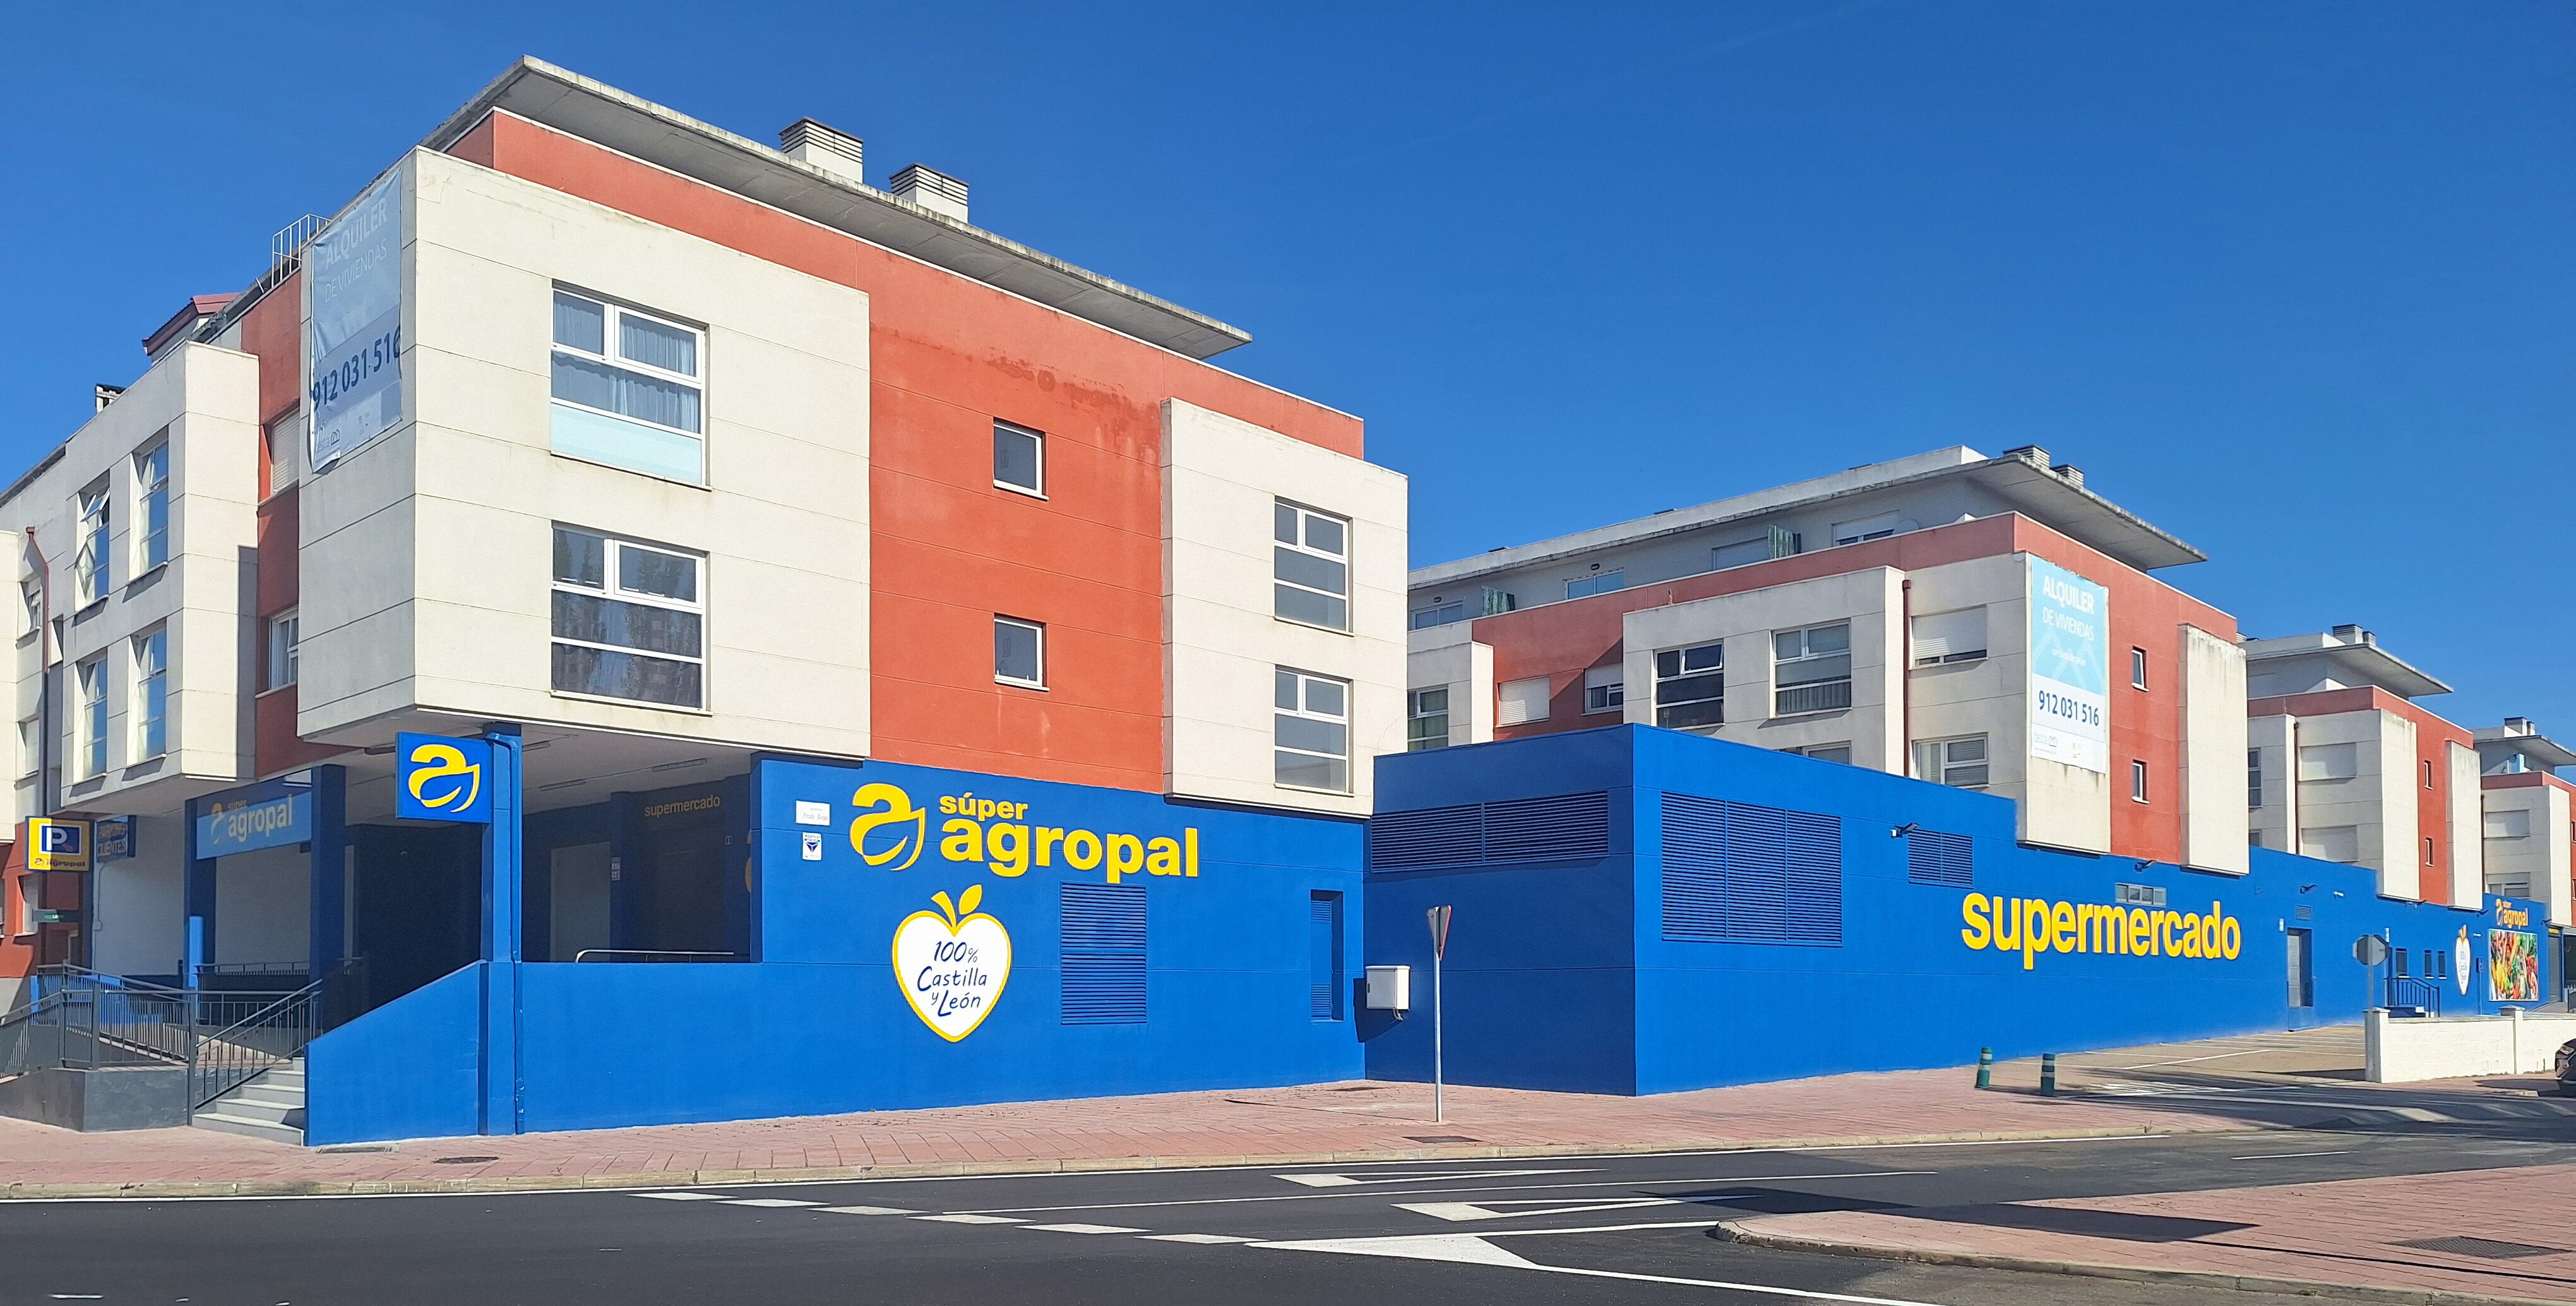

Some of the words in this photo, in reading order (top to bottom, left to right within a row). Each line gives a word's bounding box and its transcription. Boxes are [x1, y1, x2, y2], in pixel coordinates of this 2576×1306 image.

[325, 198, 387, 270] ALQUILER
[325, 282, 337, 304] DE
[337, 239, 387, 294] VIVIENDAS
[313, 369, 338, 411] 912
[342, 347, 367, 393] 031
[2042, 575, 2094, 615] ALQUILER
[2042, 606, 2054, 626] DE
[2055, 611, 2094, 642] VIVIENDAS
[2039, 690, 2058, 715] 912
[2061, 697, 2078, 721] 031
[2082, 703, 2099, 727] 516
[228, 793, 294, 843] agropal
[644, 794, 720, 819] supermercado
[939, 793, 1029, 821] súper
[46, 827, 68, 851] P
[941, 818, 1200, 885] agropal
[1961, 892, 2241, 971] supermercado
[2503, 907, 2529, 930] agropal
[934, 940, 979, 963] 100%
[917, 966, 987, 992] Castilla
[931, 992, 939, 1006] y
[937, 989, 981, 1017] León
